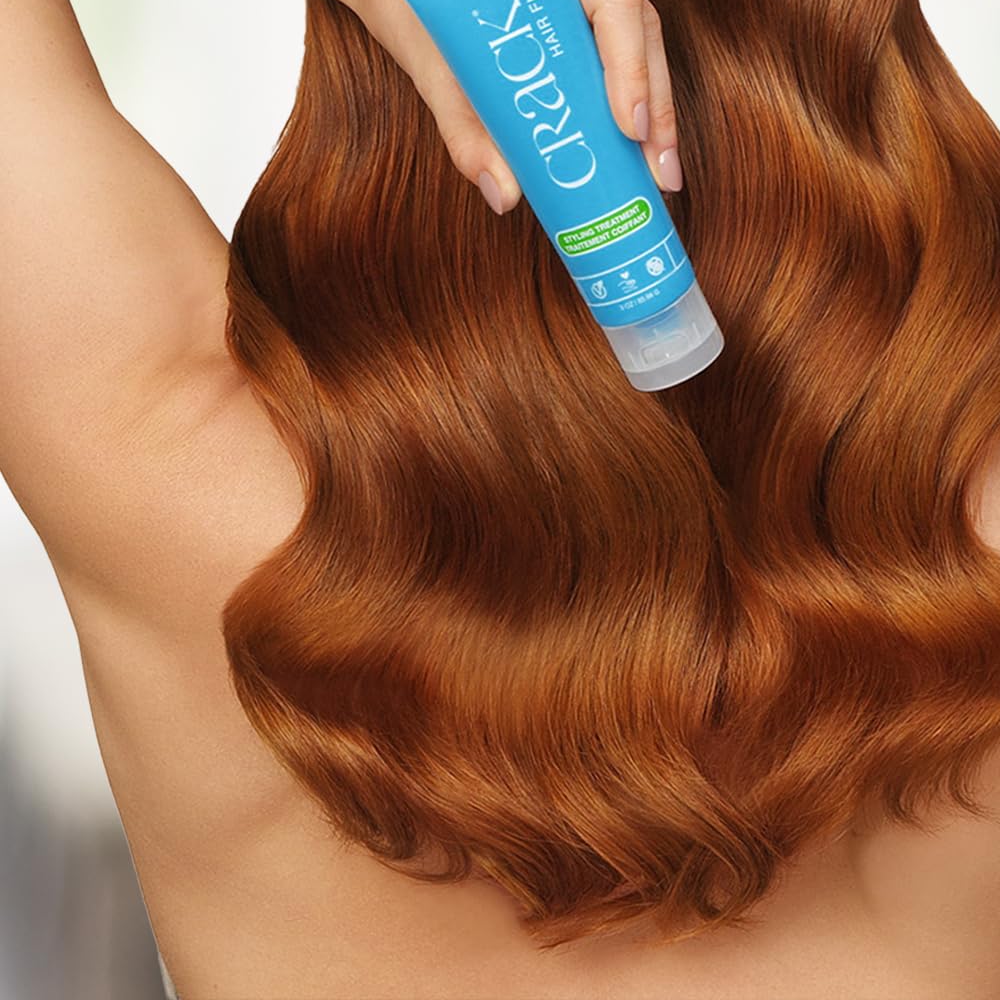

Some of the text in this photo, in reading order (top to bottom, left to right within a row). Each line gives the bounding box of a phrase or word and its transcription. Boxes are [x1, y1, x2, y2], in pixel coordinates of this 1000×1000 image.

[535, 15, 564, 58] HAIR
[563, 205, 640, 244] STYLING TREATMENT
[564, 211, 648, 253] TRAITEMENT COIFFANT
